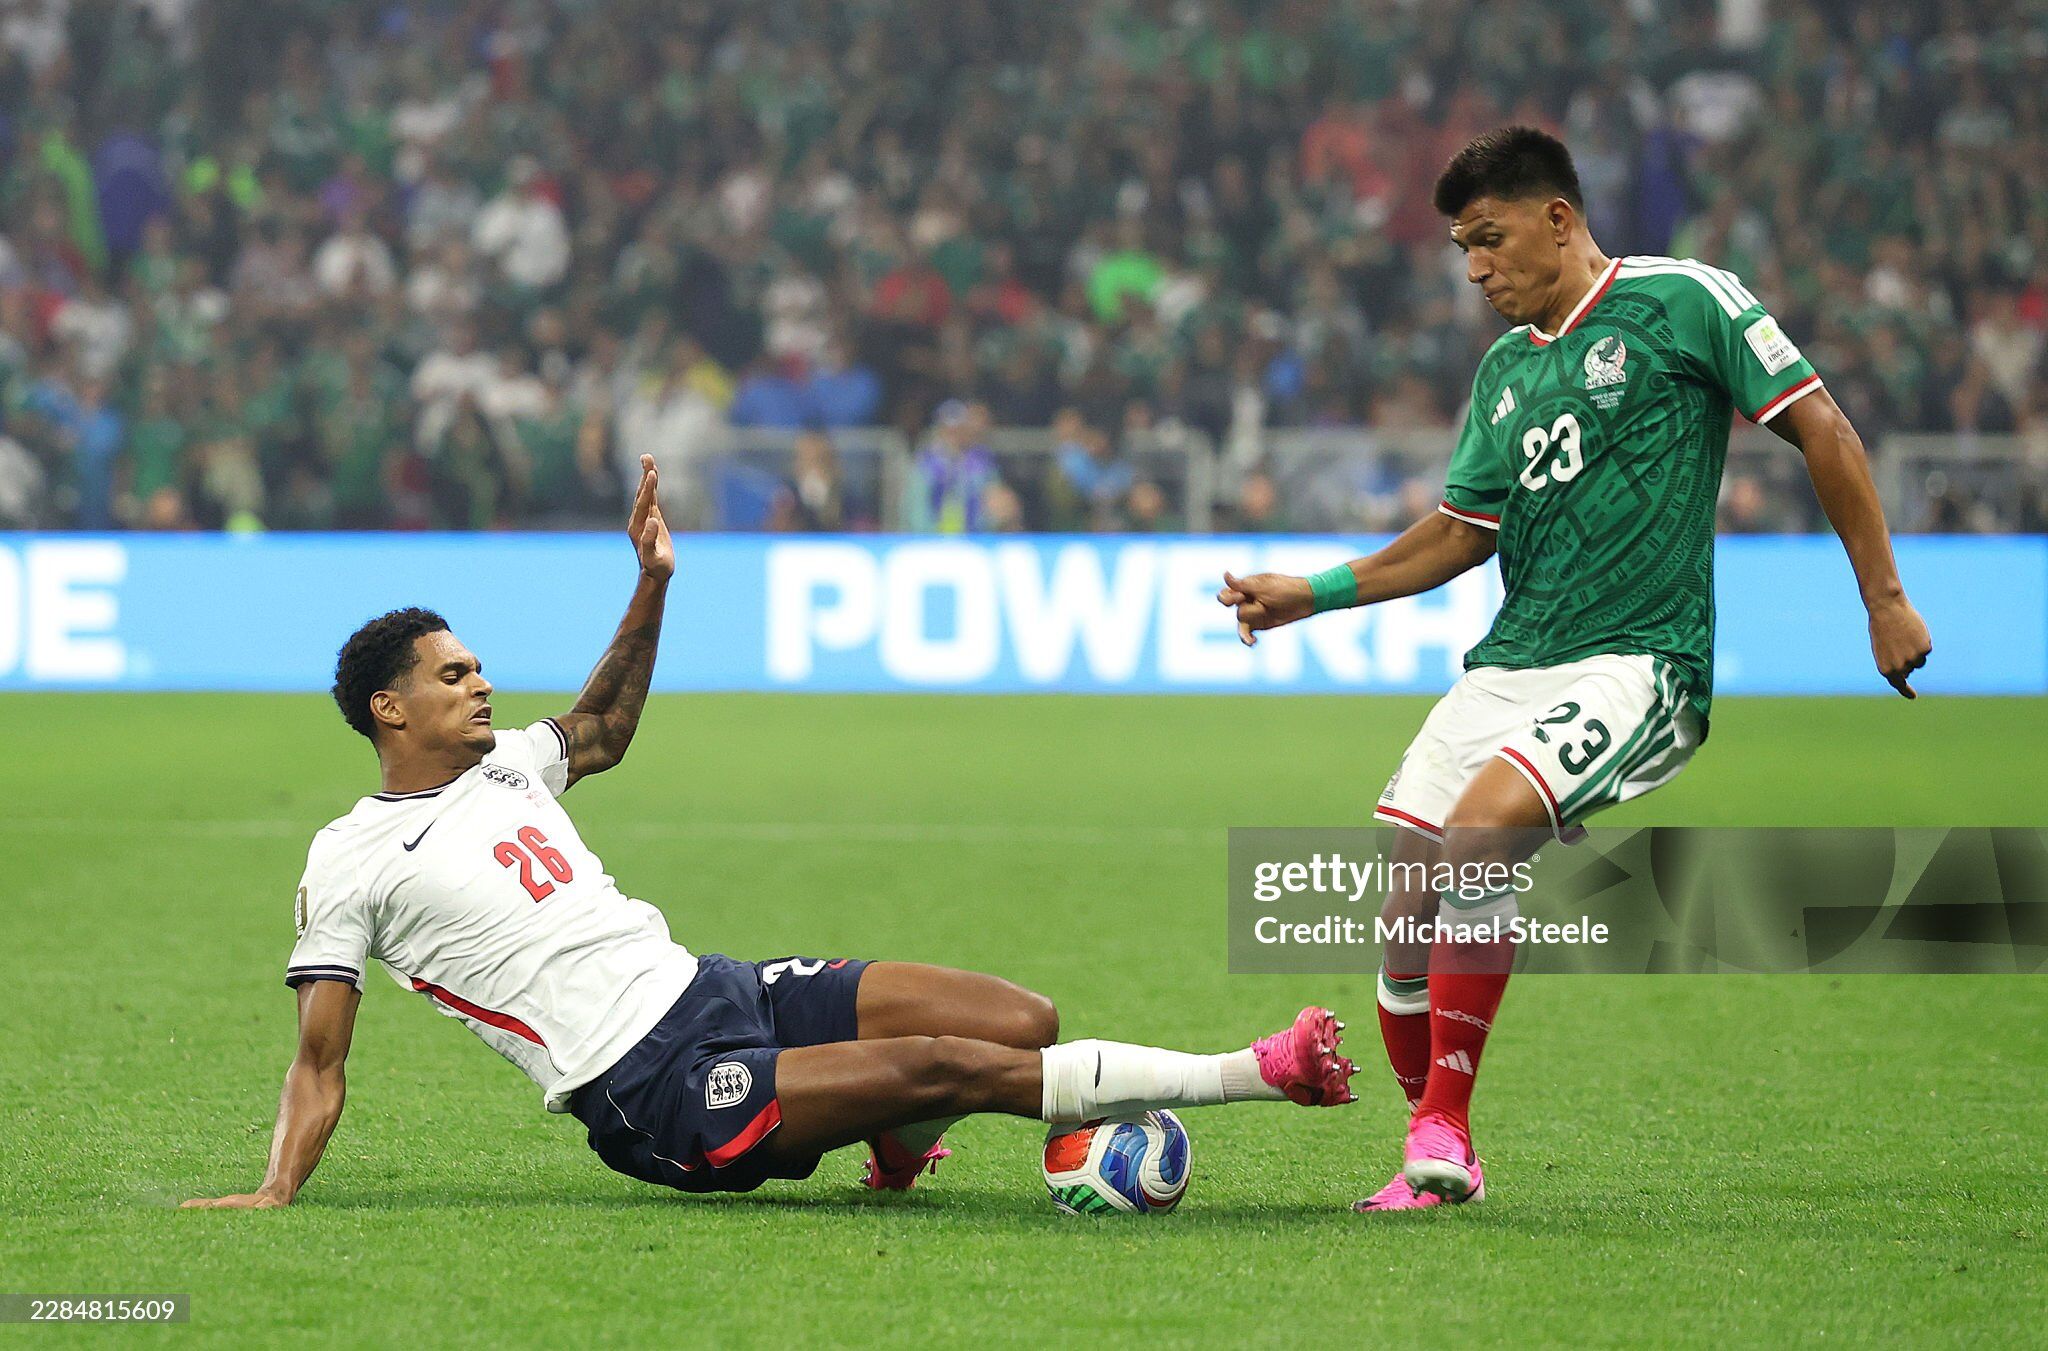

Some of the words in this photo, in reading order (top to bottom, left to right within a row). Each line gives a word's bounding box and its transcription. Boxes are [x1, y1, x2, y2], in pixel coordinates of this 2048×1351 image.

[1520, 412, 1584, 492] 23
[0, 540, 127, 682] E
[1531, 701, 1611, 776] 23
[493, 825, 573, 903] 26
